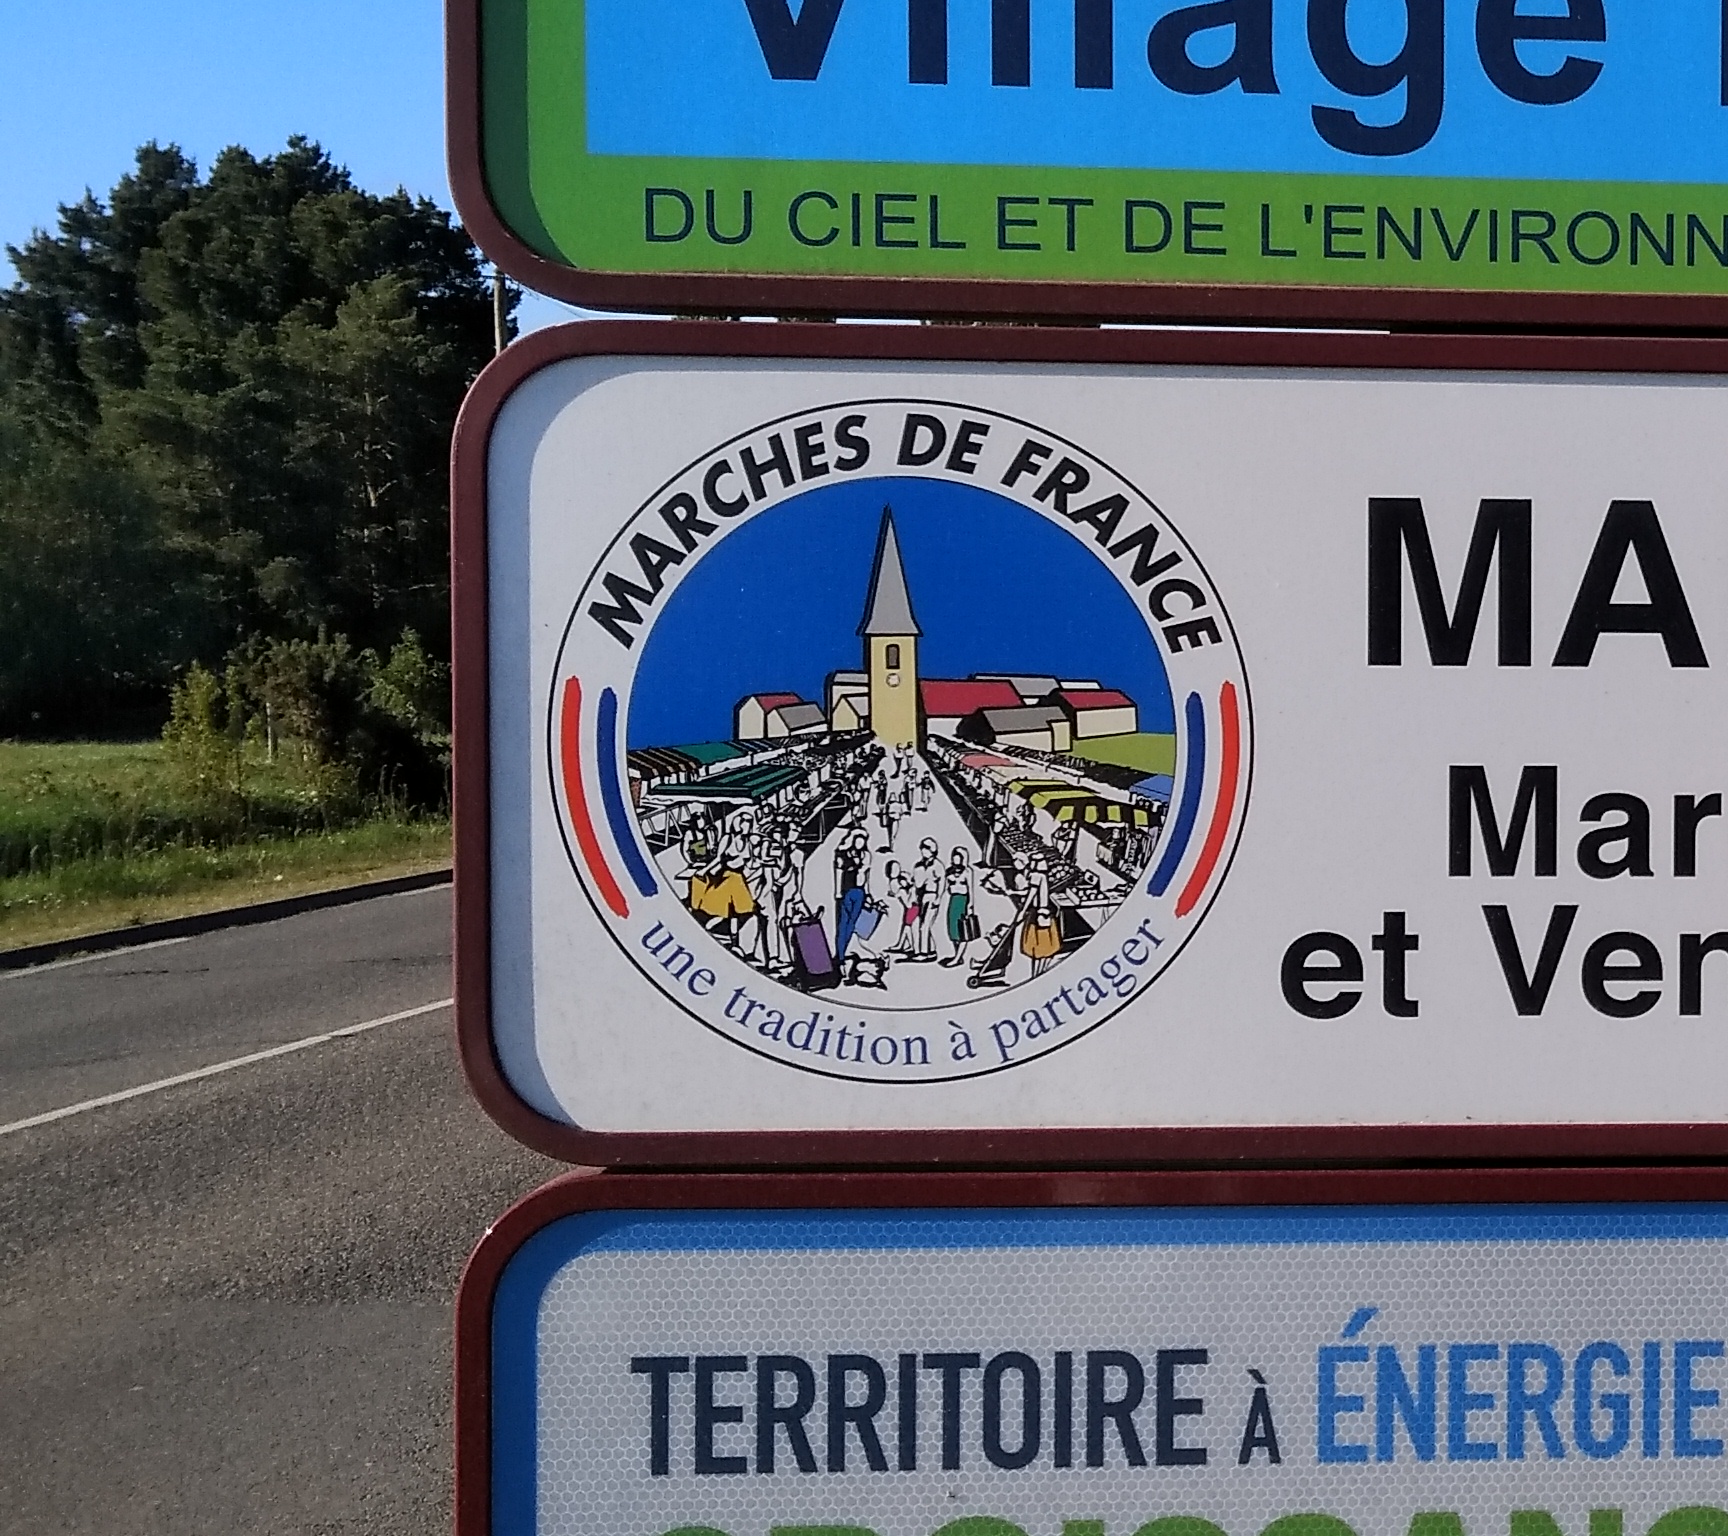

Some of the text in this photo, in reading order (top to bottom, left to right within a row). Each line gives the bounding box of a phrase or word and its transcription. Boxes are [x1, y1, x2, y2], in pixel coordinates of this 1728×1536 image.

[644, 188, 752, 244] DU
[788, 192, 965, 250] CIEL
[998, 197, 1093, 251] ET
[1124, 200, 1226, 256] DE
[587, 413, 1223, 655] MARCHES DE FRANCE
[640, 917, 1165, 1067] une tradition à partager
[1280, 912, 1419, 1019] et
[630, 1348, 1208, 1476] TERRITOIRE
[1238, 1369, 1281, 1465] À
[1317, 1307, 1725, 1464] ÉNERGIE
